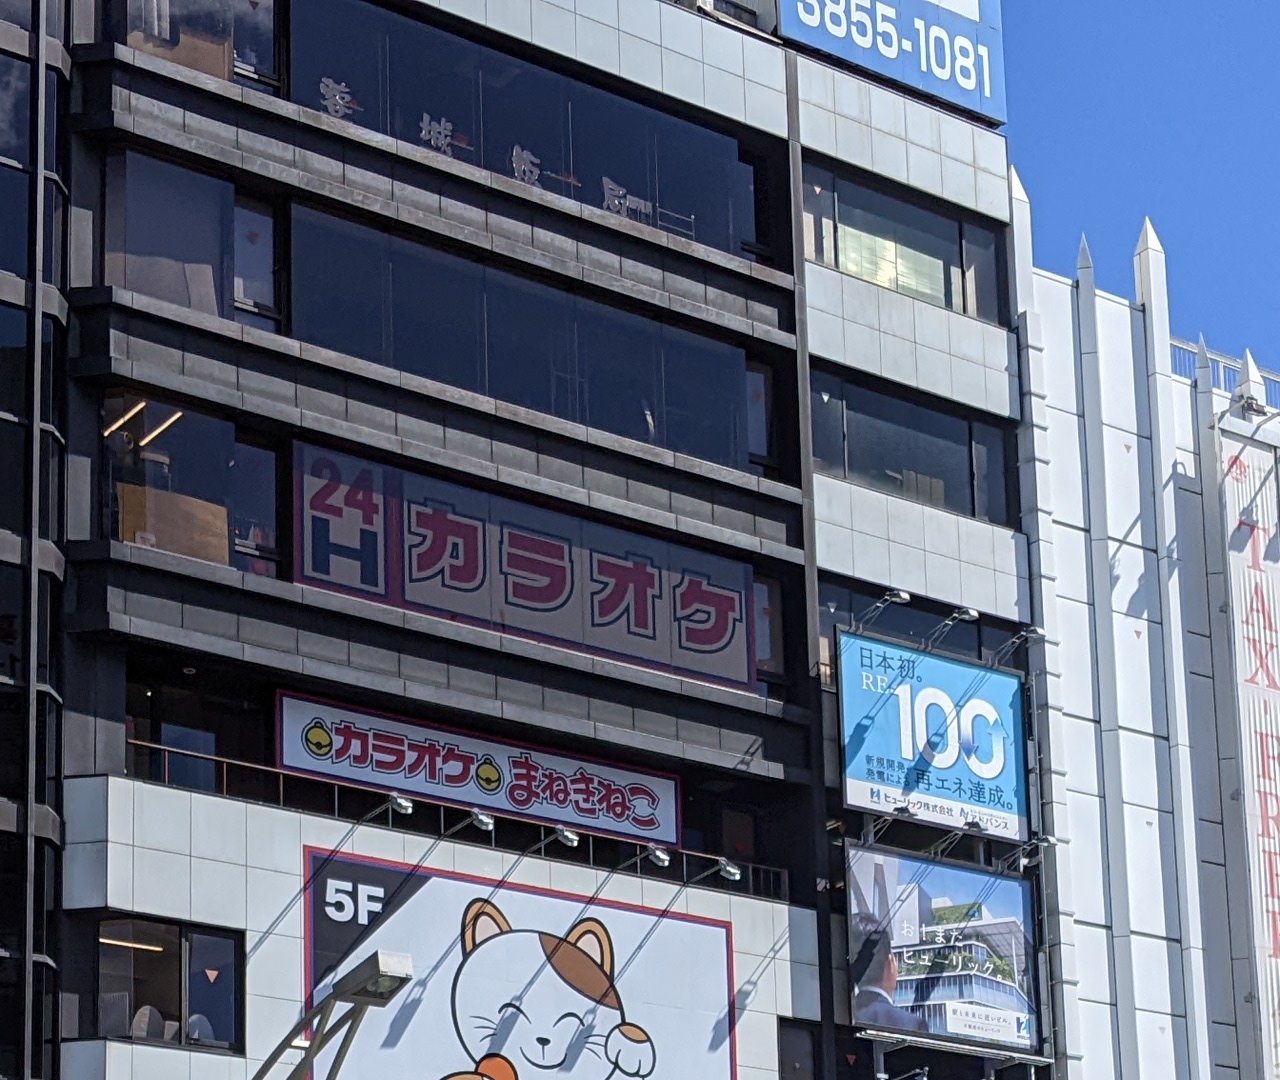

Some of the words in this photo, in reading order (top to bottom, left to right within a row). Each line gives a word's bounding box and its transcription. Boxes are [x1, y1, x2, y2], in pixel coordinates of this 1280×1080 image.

[309, 455, 379, 527] 24
[313, 515, 377, 584] H
[404, 499, 744, 656] カラオケ
[332, 720, 477, 784] カラオケ
[505, 754, 661, 831] まねきねこ
[324, 878, 385, 924] 5F
